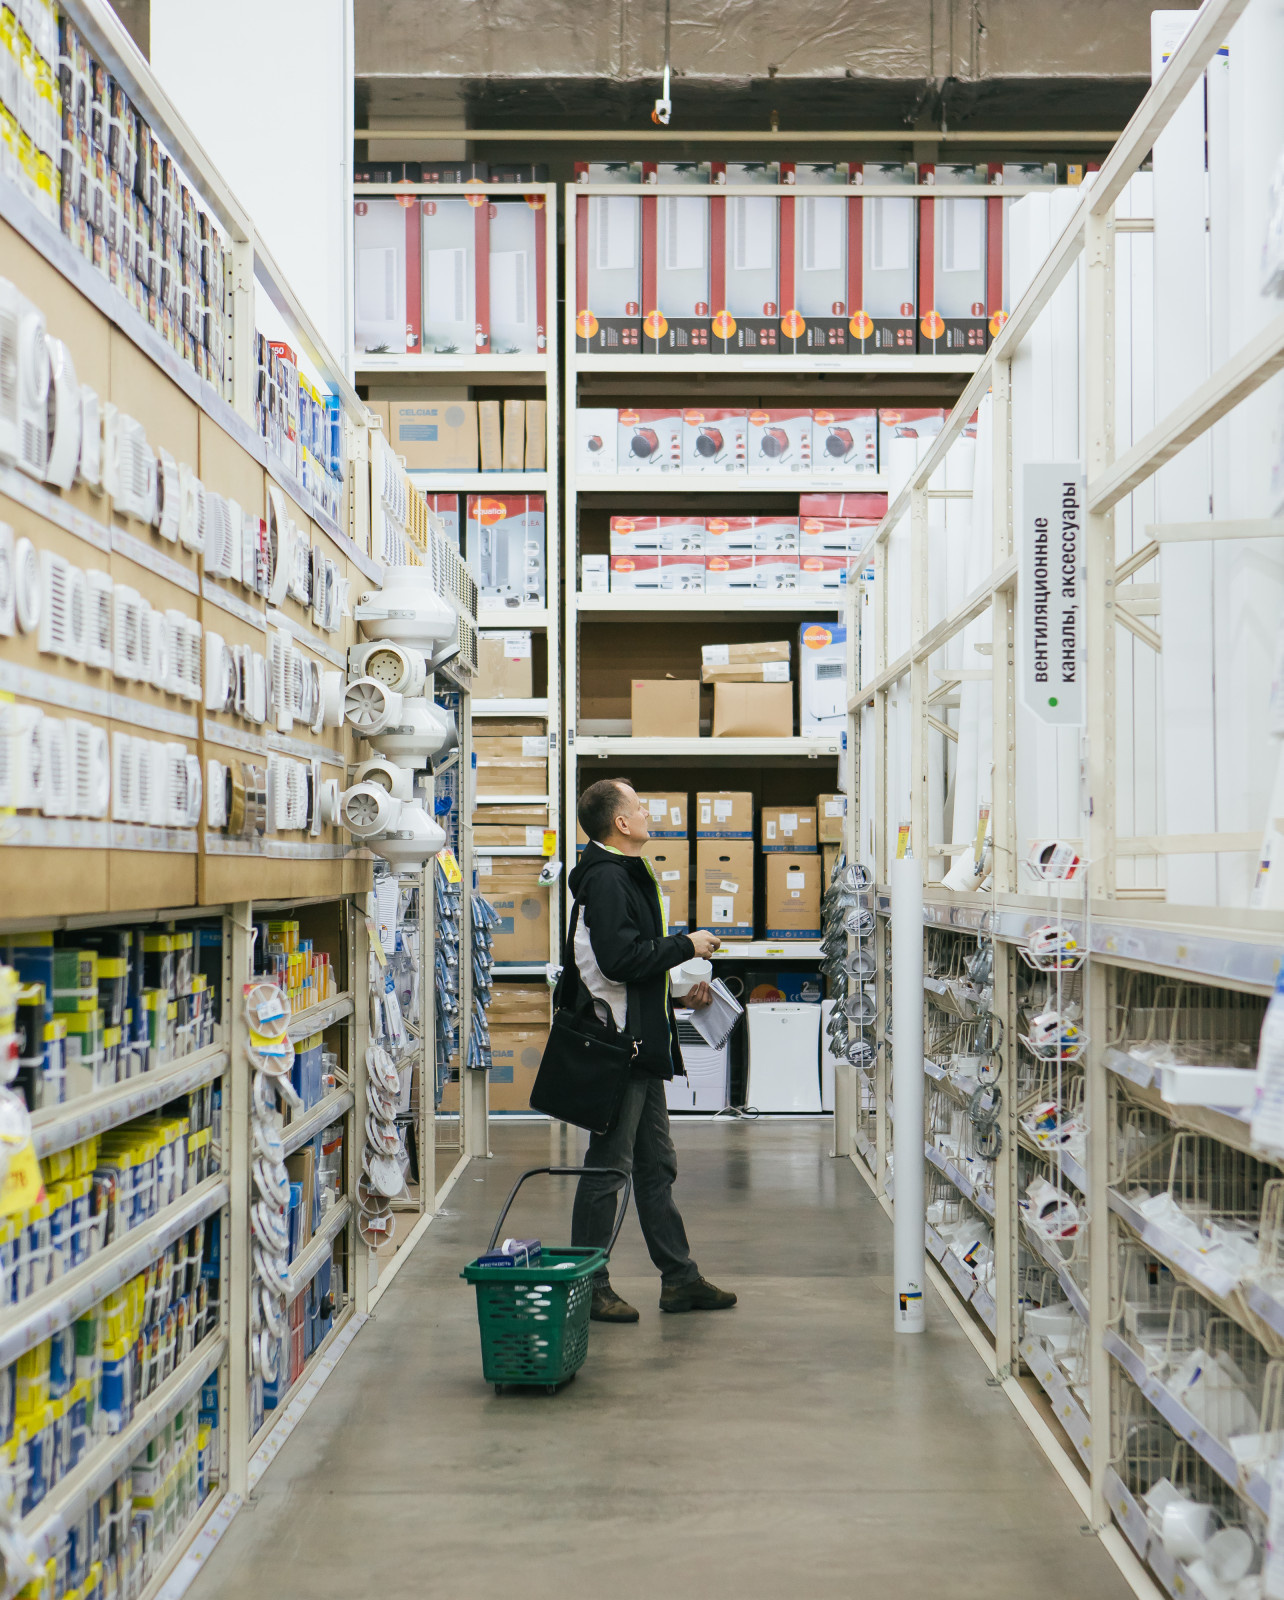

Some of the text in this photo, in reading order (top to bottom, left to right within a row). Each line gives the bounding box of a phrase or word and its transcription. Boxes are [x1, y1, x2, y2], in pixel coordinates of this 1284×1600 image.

[1034, 516, 1051, 683] вентиляционные
[1061, 481, 1080, 683] каналы, аксессуары
[802, 981, 809, 993] 2
